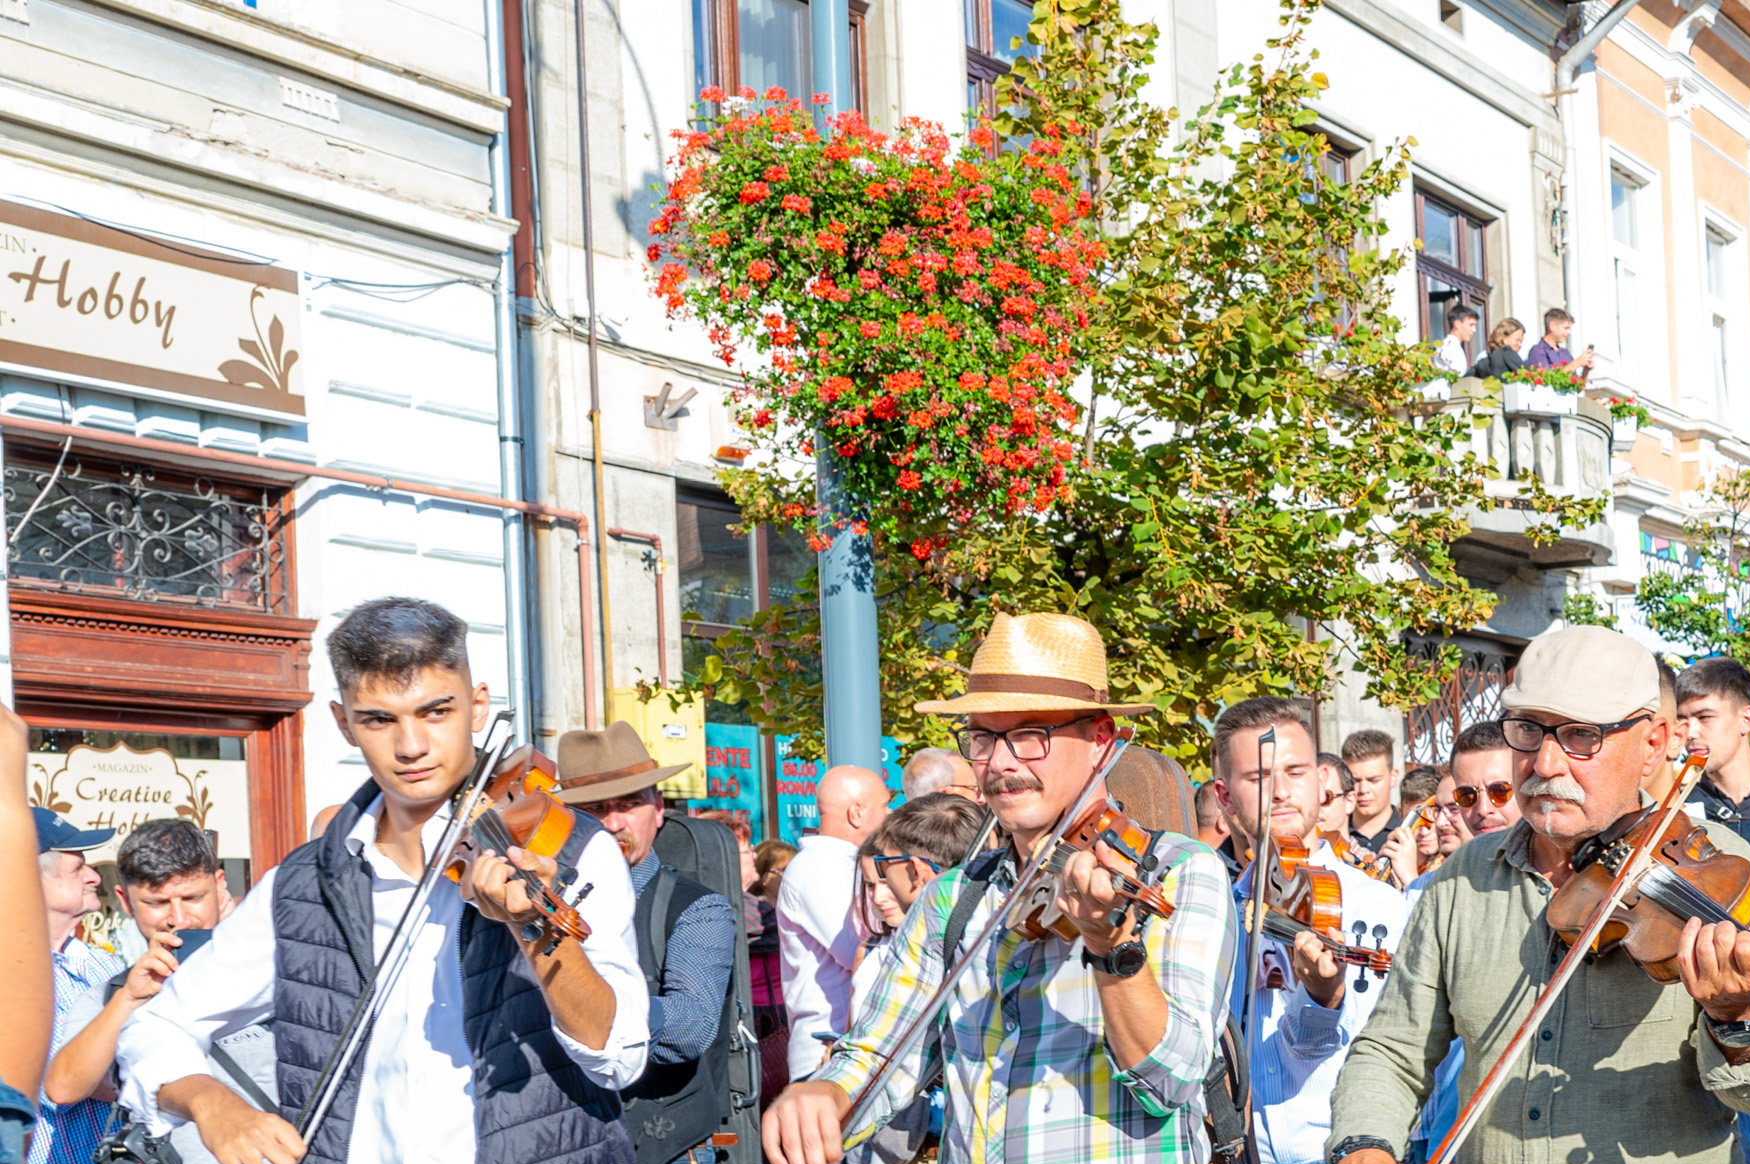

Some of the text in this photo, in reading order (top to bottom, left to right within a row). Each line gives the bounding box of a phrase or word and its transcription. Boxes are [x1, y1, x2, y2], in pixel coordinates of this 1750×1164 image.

[0, 233, 26, 255] IN
[8, 255, 176, 349] Hobby
[75, 777, 173, 804] Creative
[786, 803, 817, 819] LUNI
